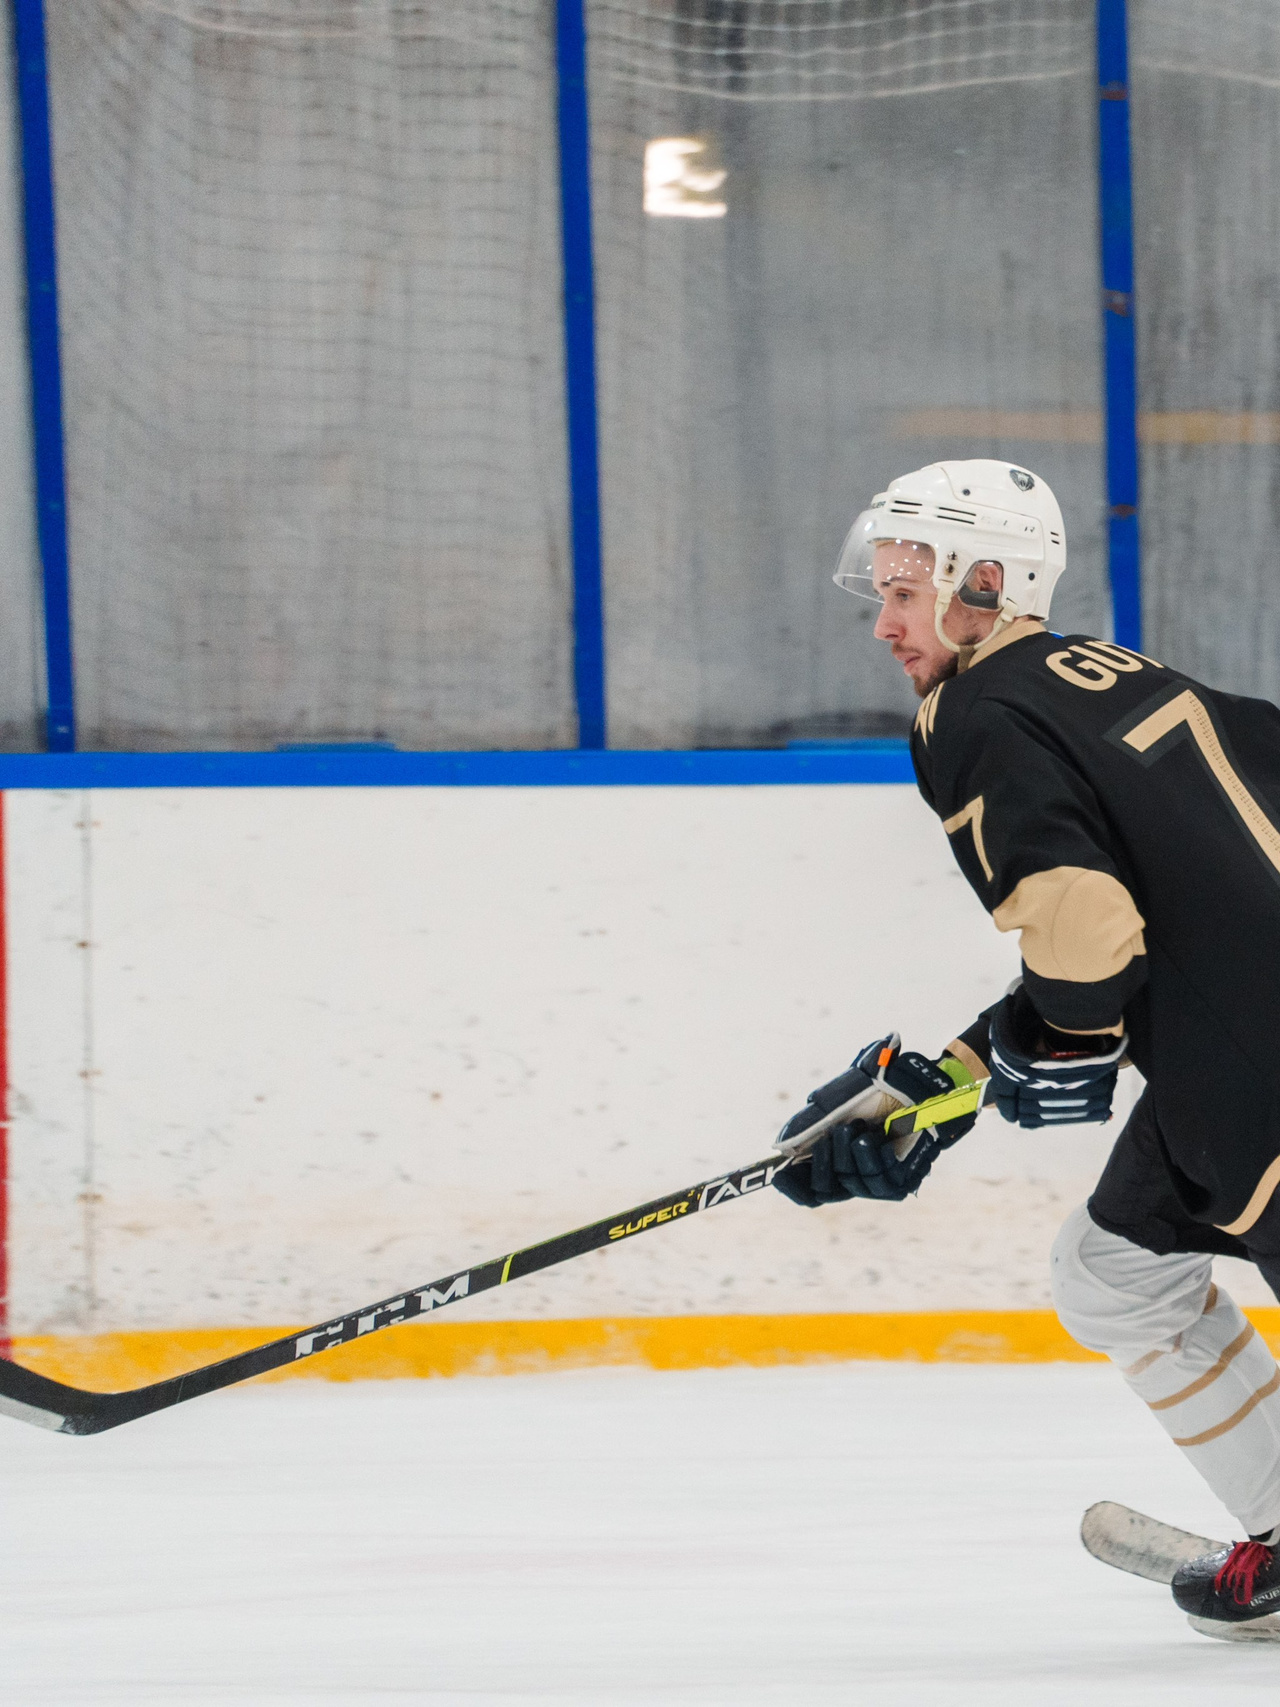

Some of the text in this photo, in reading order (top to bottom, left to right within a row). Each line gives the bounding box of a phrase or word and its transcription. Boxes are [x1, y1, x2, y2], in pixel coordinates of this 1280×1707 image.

[1045, 640, 1165, 692] GU
[942, 795, 994, 882] 7
[609, 1201, 690, 1240] SUPER
